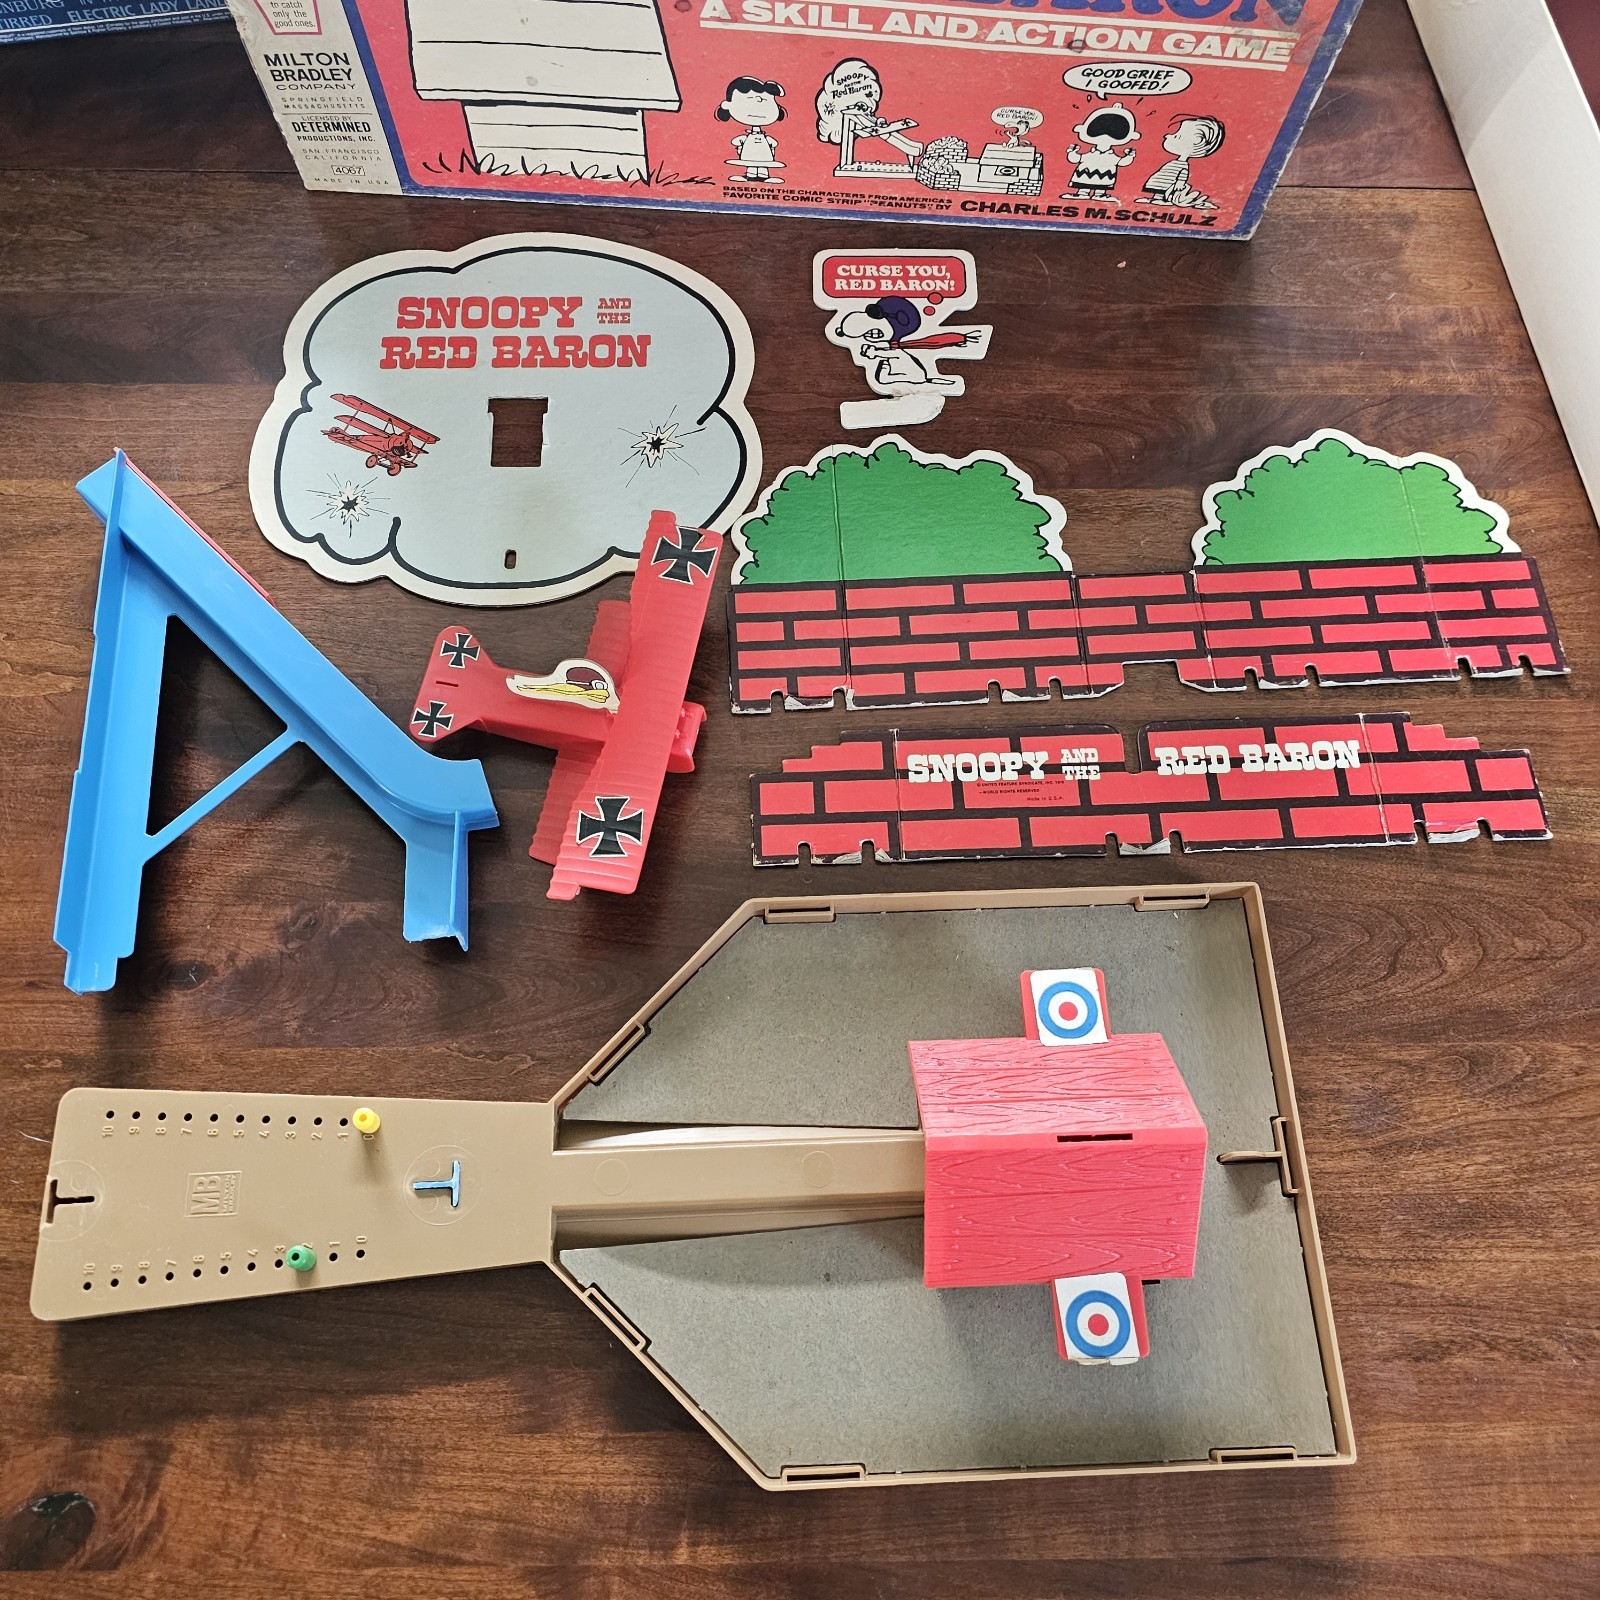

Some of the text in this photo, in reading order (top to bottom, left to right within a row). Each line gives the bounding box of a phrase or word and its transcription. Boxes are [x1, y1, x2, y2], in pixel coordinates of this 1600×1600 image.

[67, 4, 136, 22] ELECTRIC
[139, 0, 178, 15] LADY
[272, 10, 307, 19] only the
[274, 19, 316, 29] good ones.
[700, 0, 731, 20] A
[742, 2, 873, 31] SKILL
[881, 12, 979, 40] AND
[985, 22, 1152, 52] ACTION
[1162, 33, 1295, 63] GAME
[263, 52, 351, 67] MILTON
[270, 68, 352, 82] BRADLEY
[837, 73, 869, 86] SNOOPY
[1081, 68, 1175, 80] GOOD GRIEF
[830, 84, 872, 99] Red Baron
[1086, 79, 1169, 91] I GOOFED!
[291, 121, 371, 133] DETERMINED
[335, 166, 362, 175] 4067
[723, 192, 779, 201] FAVORITE
[782, 195, 823, 203] COMIC
[827, 197, 862, 205] STRIP
[797, 189, 865, 199] CHARACTERS
[960, 200, 1079, 218] CHARLES
[837, 265, 951, 279] CURSE YOU,
[834, 278, 955, 292] RED BARON!
[397, 296, 632, 329] SNOOPY AND
[597, 312, 631, 324] THE
[379, 334, 651, 370] RED BARON
[1154, 740, 1361, 775] RED BARON
[907, 747, 1099, 783] SNOOPY AND
[1061, 765, 1101, 780] THE
[190, 1175, 220, 1215] MB
